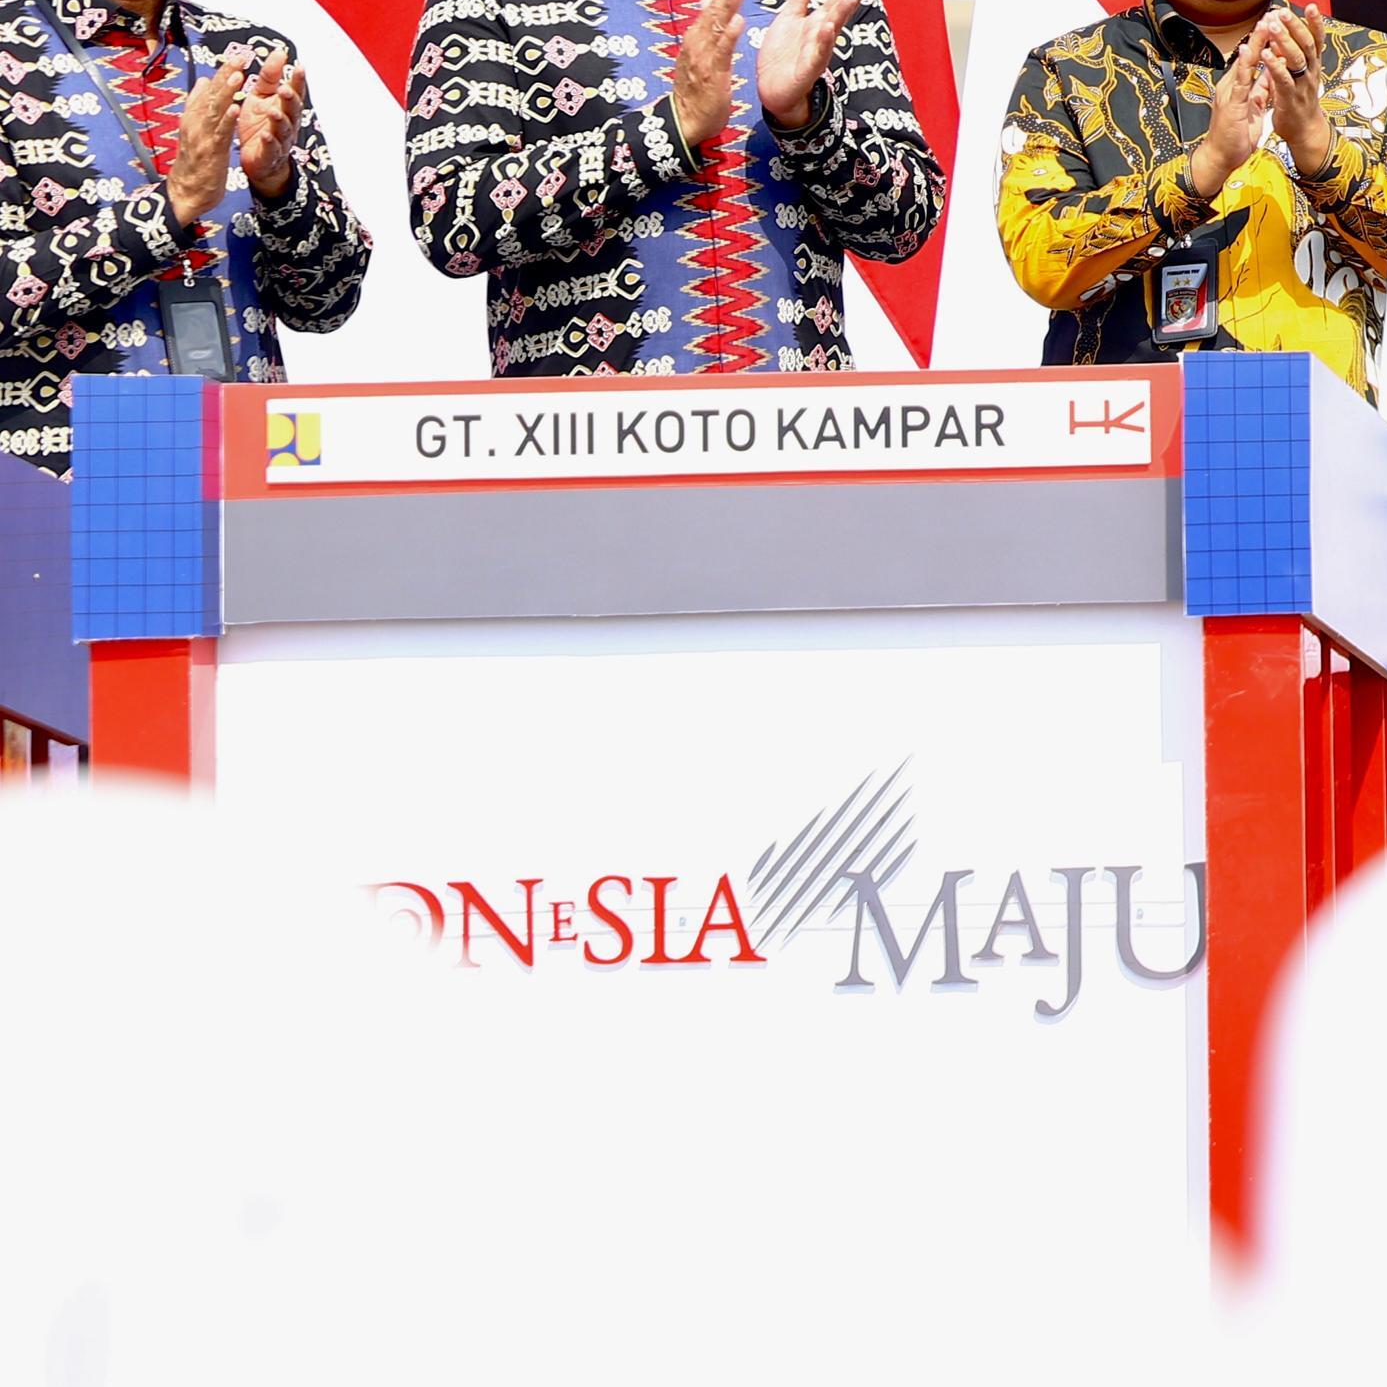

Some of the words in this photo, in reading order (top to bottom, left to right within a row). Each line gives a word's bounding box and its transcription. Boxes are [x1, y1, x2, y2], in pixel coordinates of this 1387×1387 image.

[415, 415, 497, 458] GT.
[514, 412, 595, 456] XIII
[616, 408, 756, 455] KOTO
[777, 405, 1005, 451] KAMPAR
[1069, 399, 1146, 435] HK
[834, 860, 1206, 1017] MAJU
